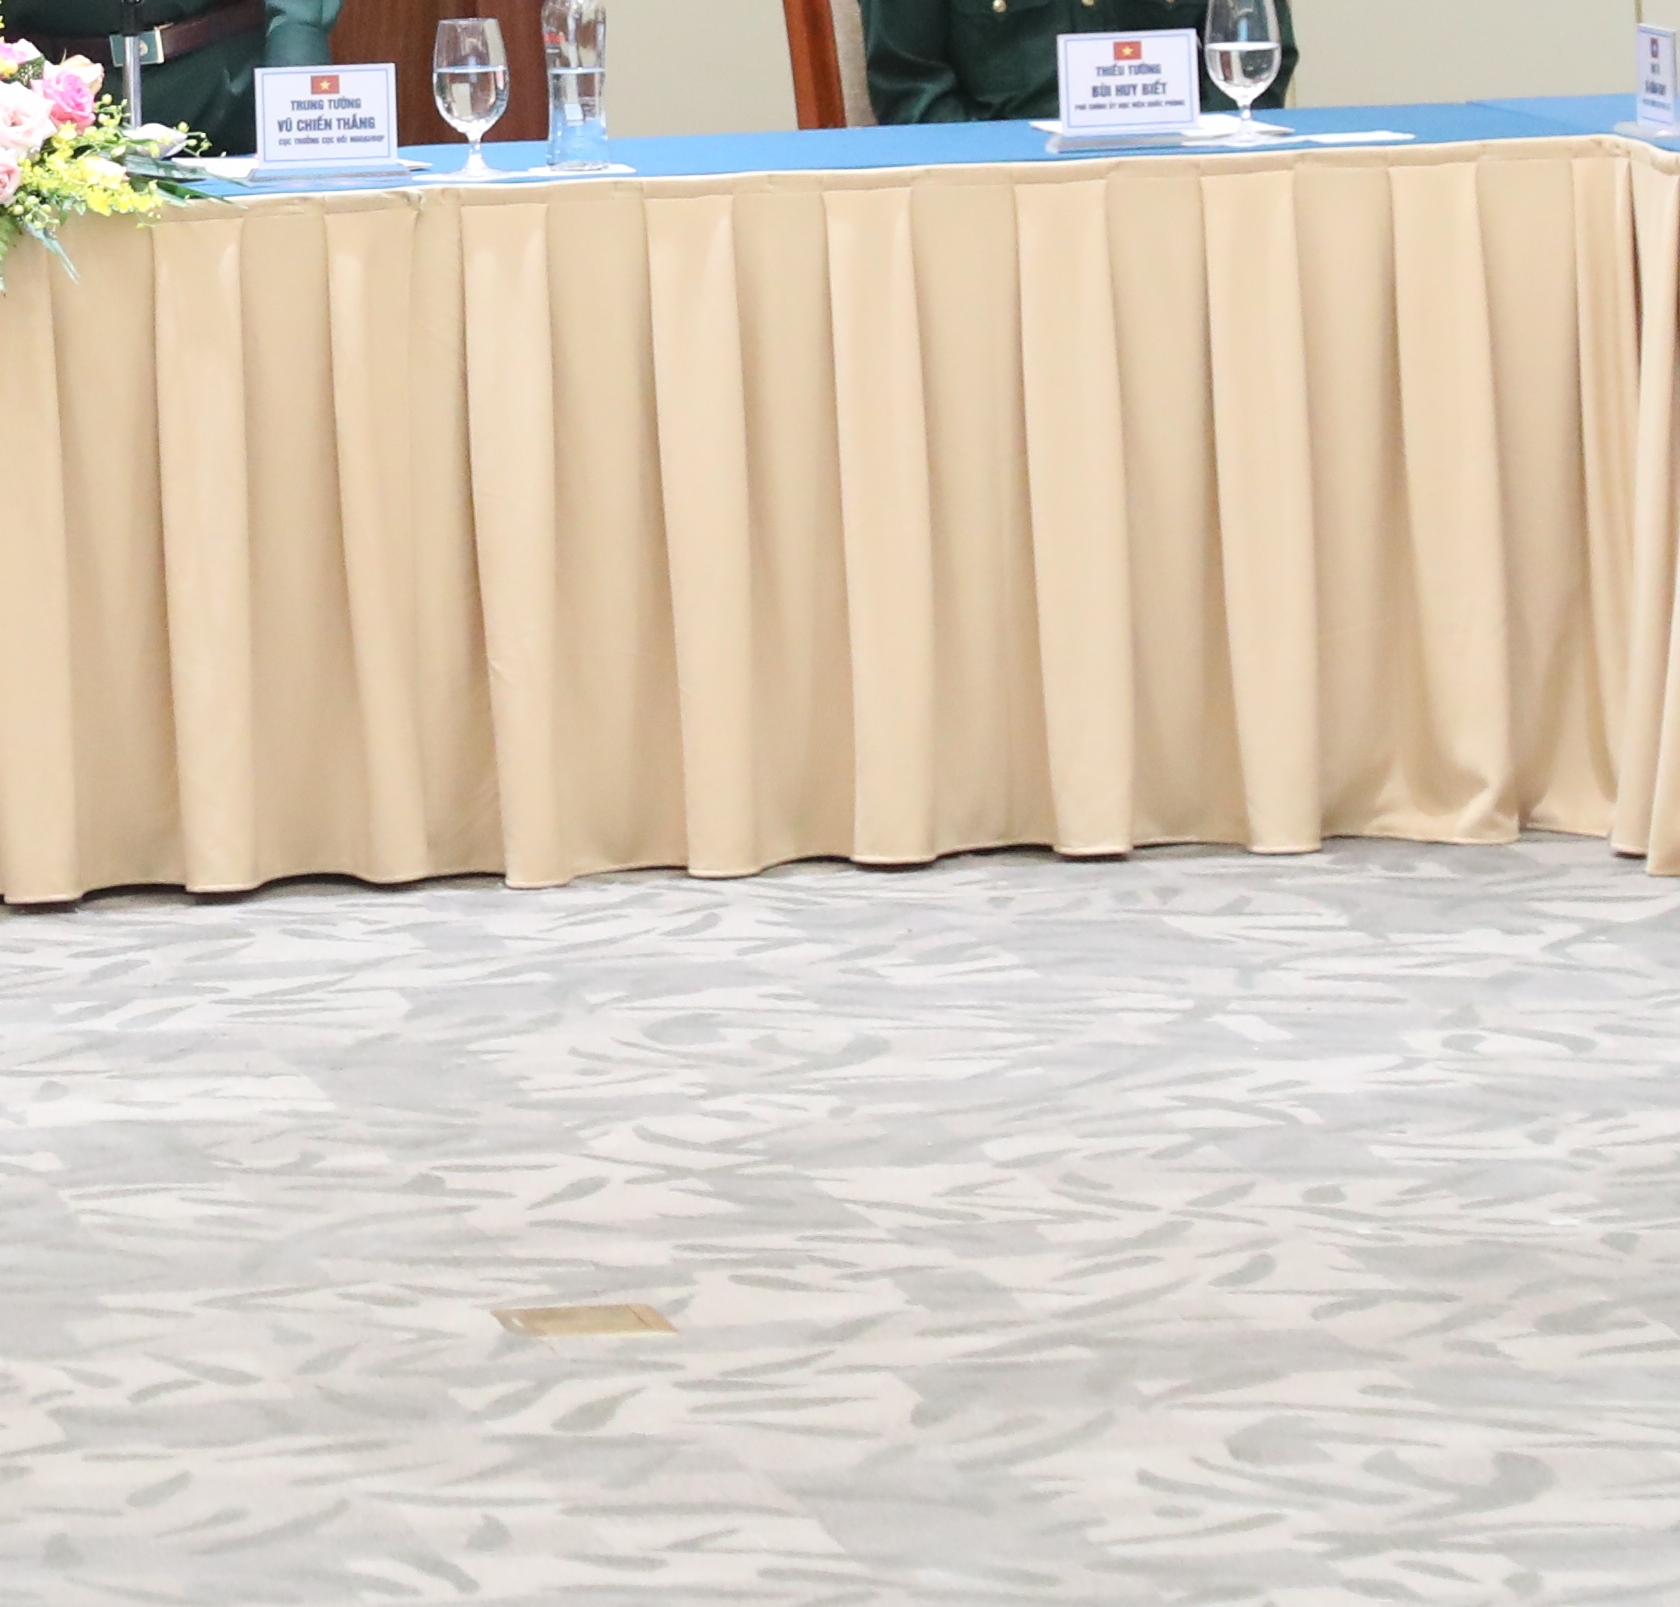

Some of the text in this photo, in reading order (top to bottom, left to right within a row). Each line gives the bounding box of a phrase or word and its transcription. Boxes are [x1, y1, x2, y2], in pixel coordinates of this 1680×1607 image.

[290, 100, 324, 111] TRUNG
[277, 117, 292, 132] VŨ
[297, 114, 332, 131] CHIẾN
